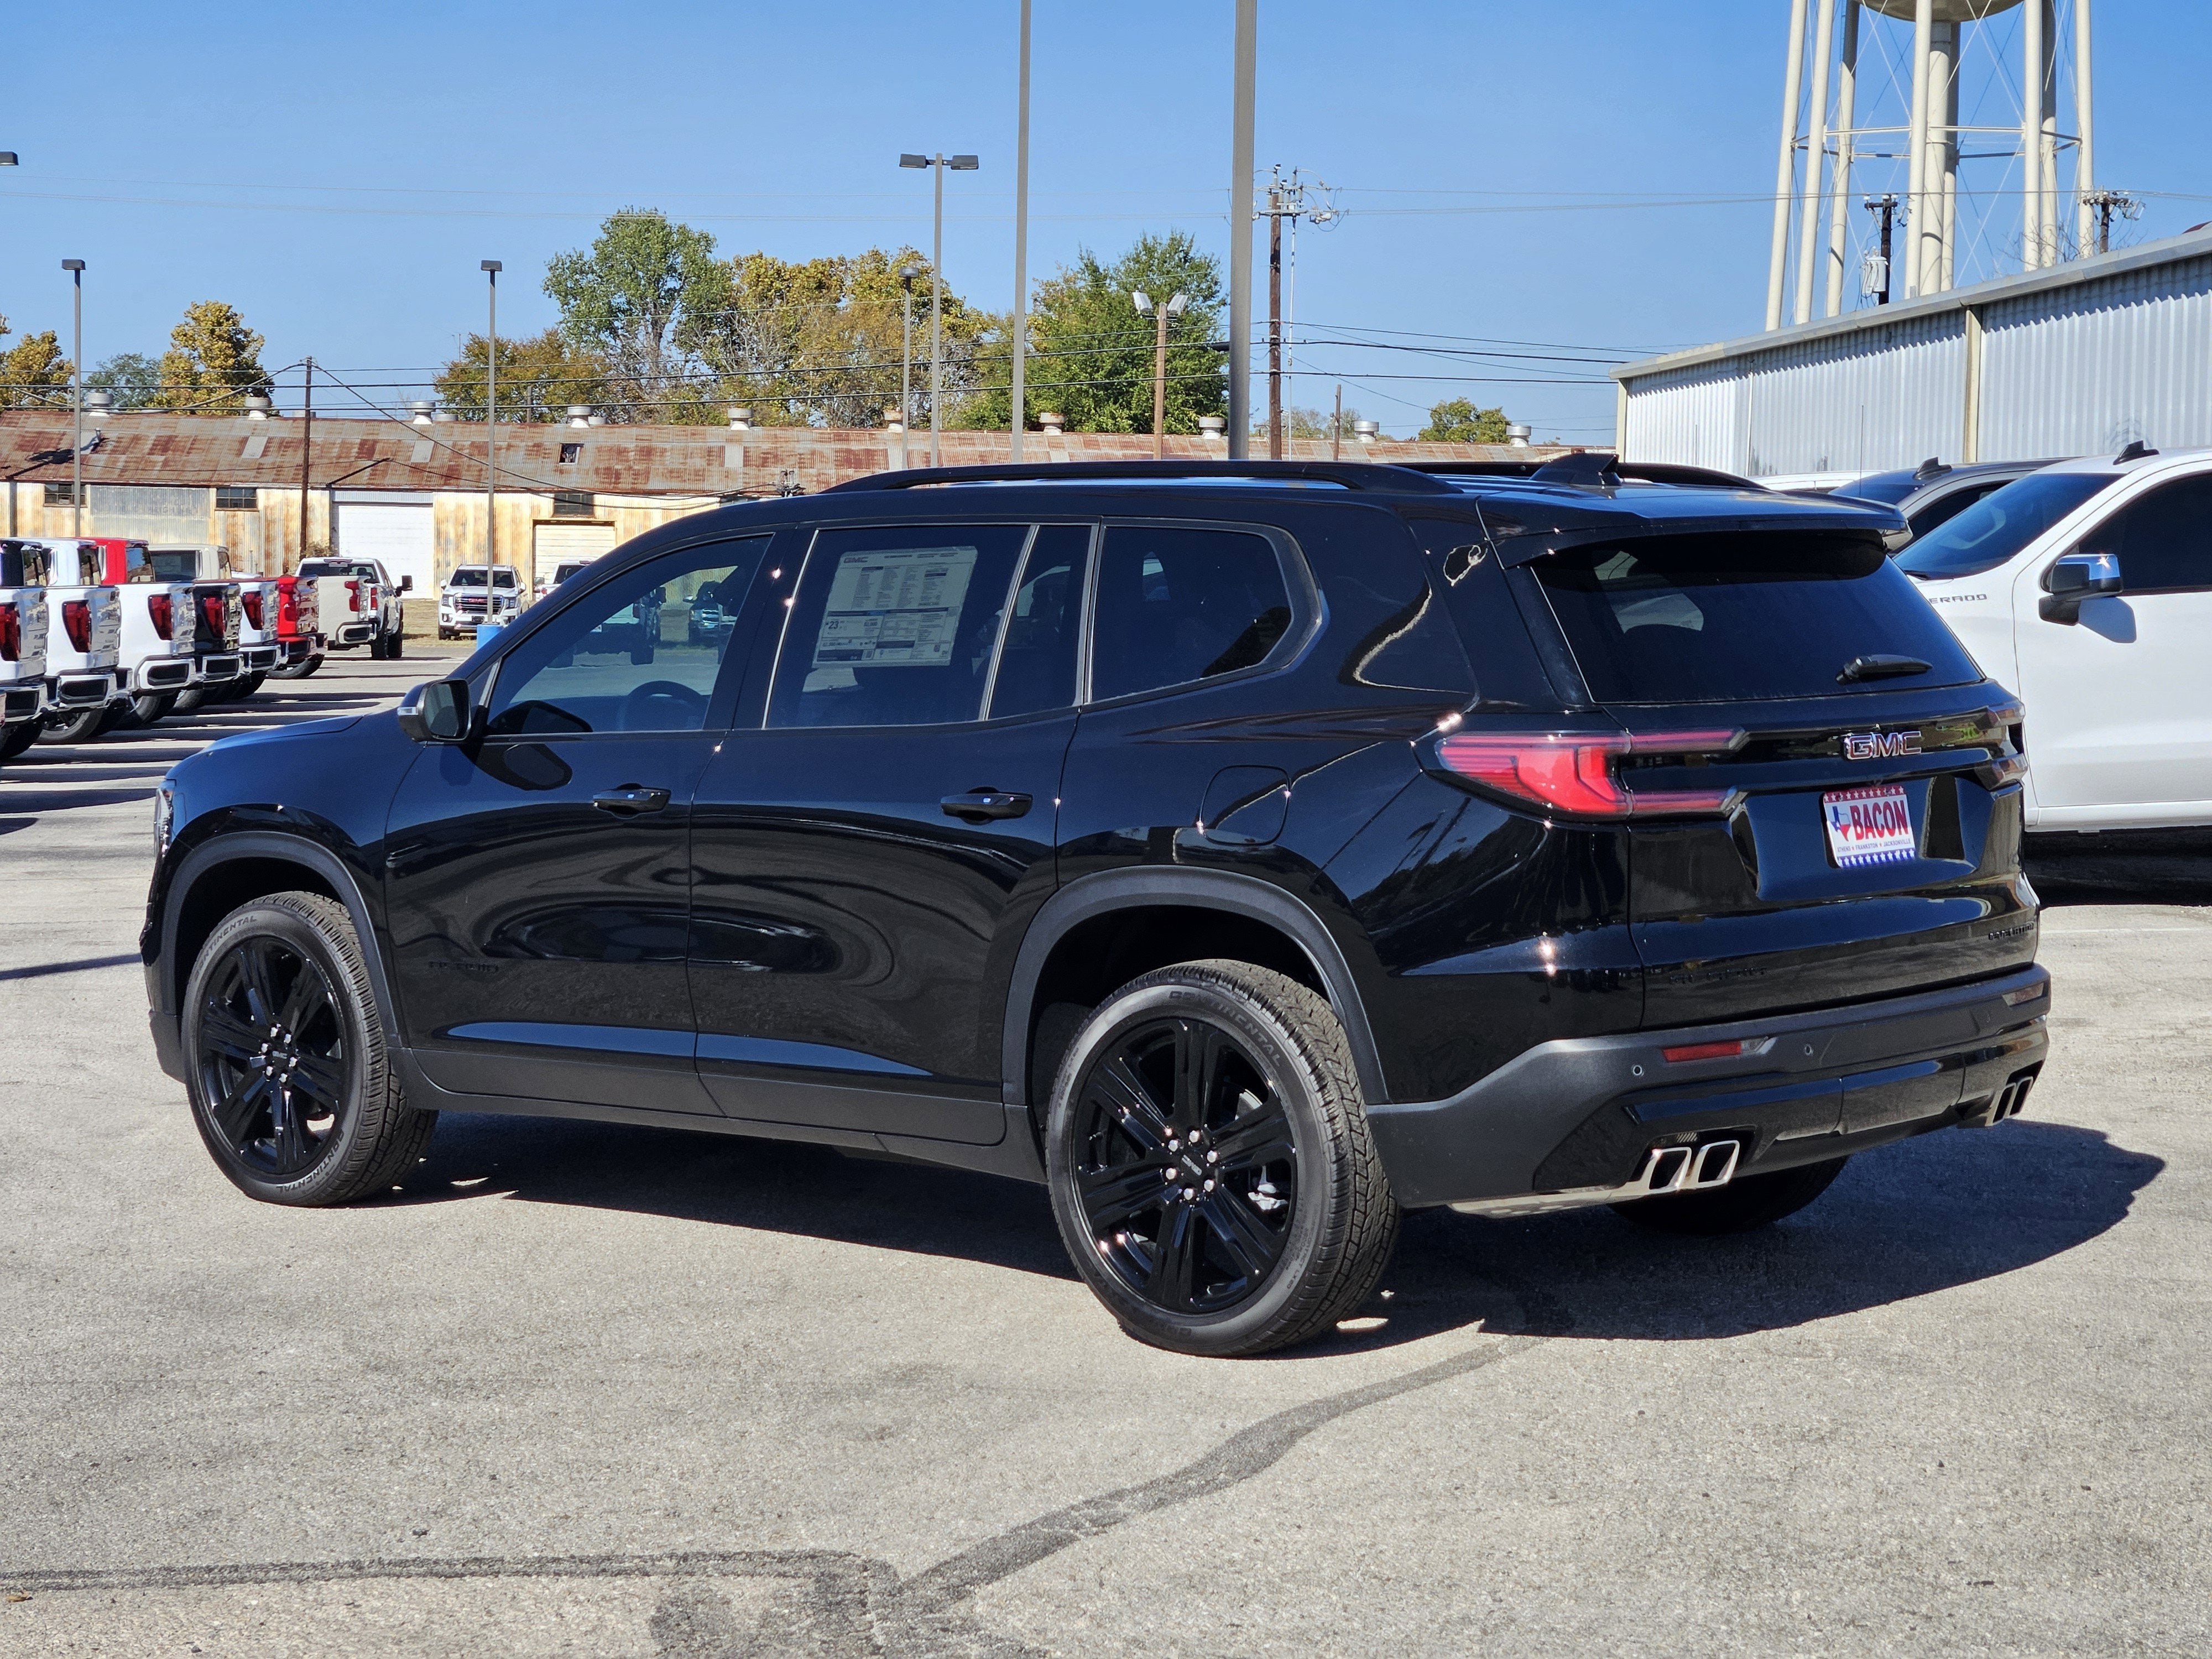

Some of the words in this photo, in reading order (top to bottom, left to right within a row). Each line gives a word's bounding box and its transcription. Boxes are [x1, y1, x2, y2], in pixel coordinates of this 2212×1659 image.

[828, 620, 839, 629] 23
[1844, 731, 1922, 760] GMC
[1849, 800, 1909, 841] BACON
[1855, 842, 1879, 851] FRANKSTON
[1884, 838, 1912, 847] JACKSONVILLE
